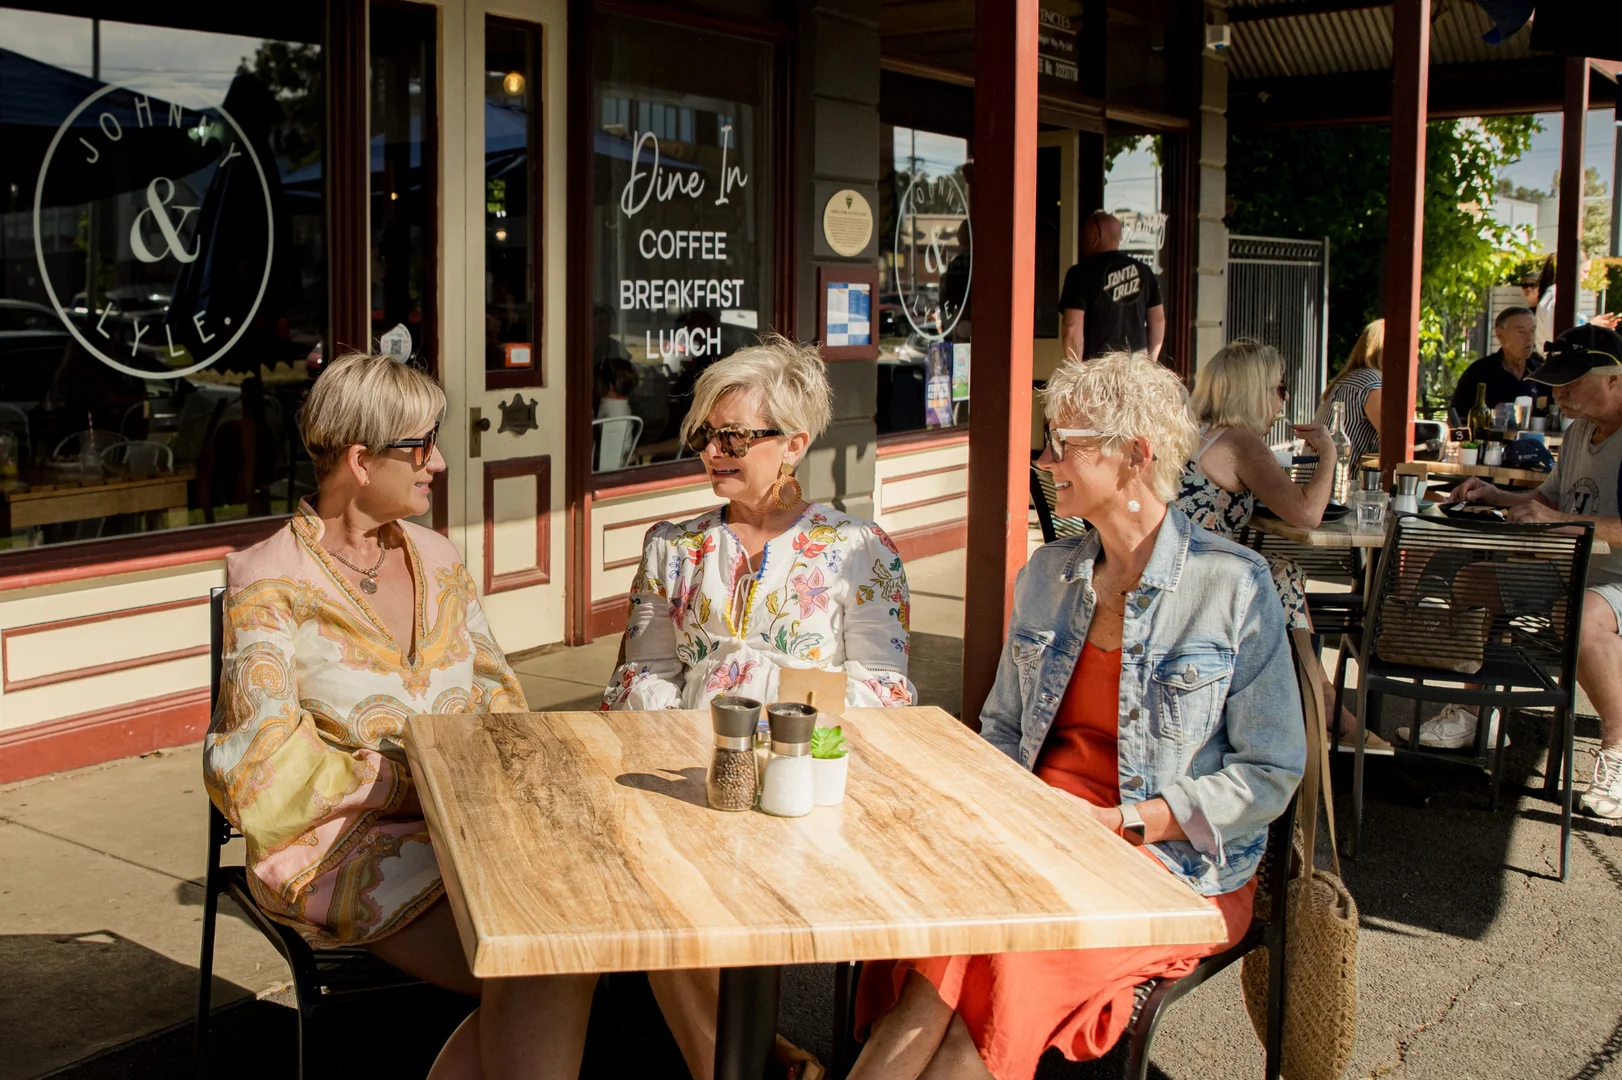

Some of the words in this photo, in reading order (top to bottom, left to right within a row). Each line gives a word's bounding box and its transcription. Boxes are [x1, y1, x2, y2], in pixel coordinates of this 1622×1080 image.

[79, 95, 242, 167] JOHNNY
[621, 131, 705, 218] Dine
[715, 125, 748, 206] In
[130, 177, 201, 263] &
[639, 229, 727, 260] COFFEE
[1103, 264, 1139, 291] SANTA
[1113, 277, 1140, 302] CRUZ
[620, 279, 744, 310] BREAKFAST
[646, 327, 721, 360] LUNCH
[1455, 430, 1464, 440] 3
